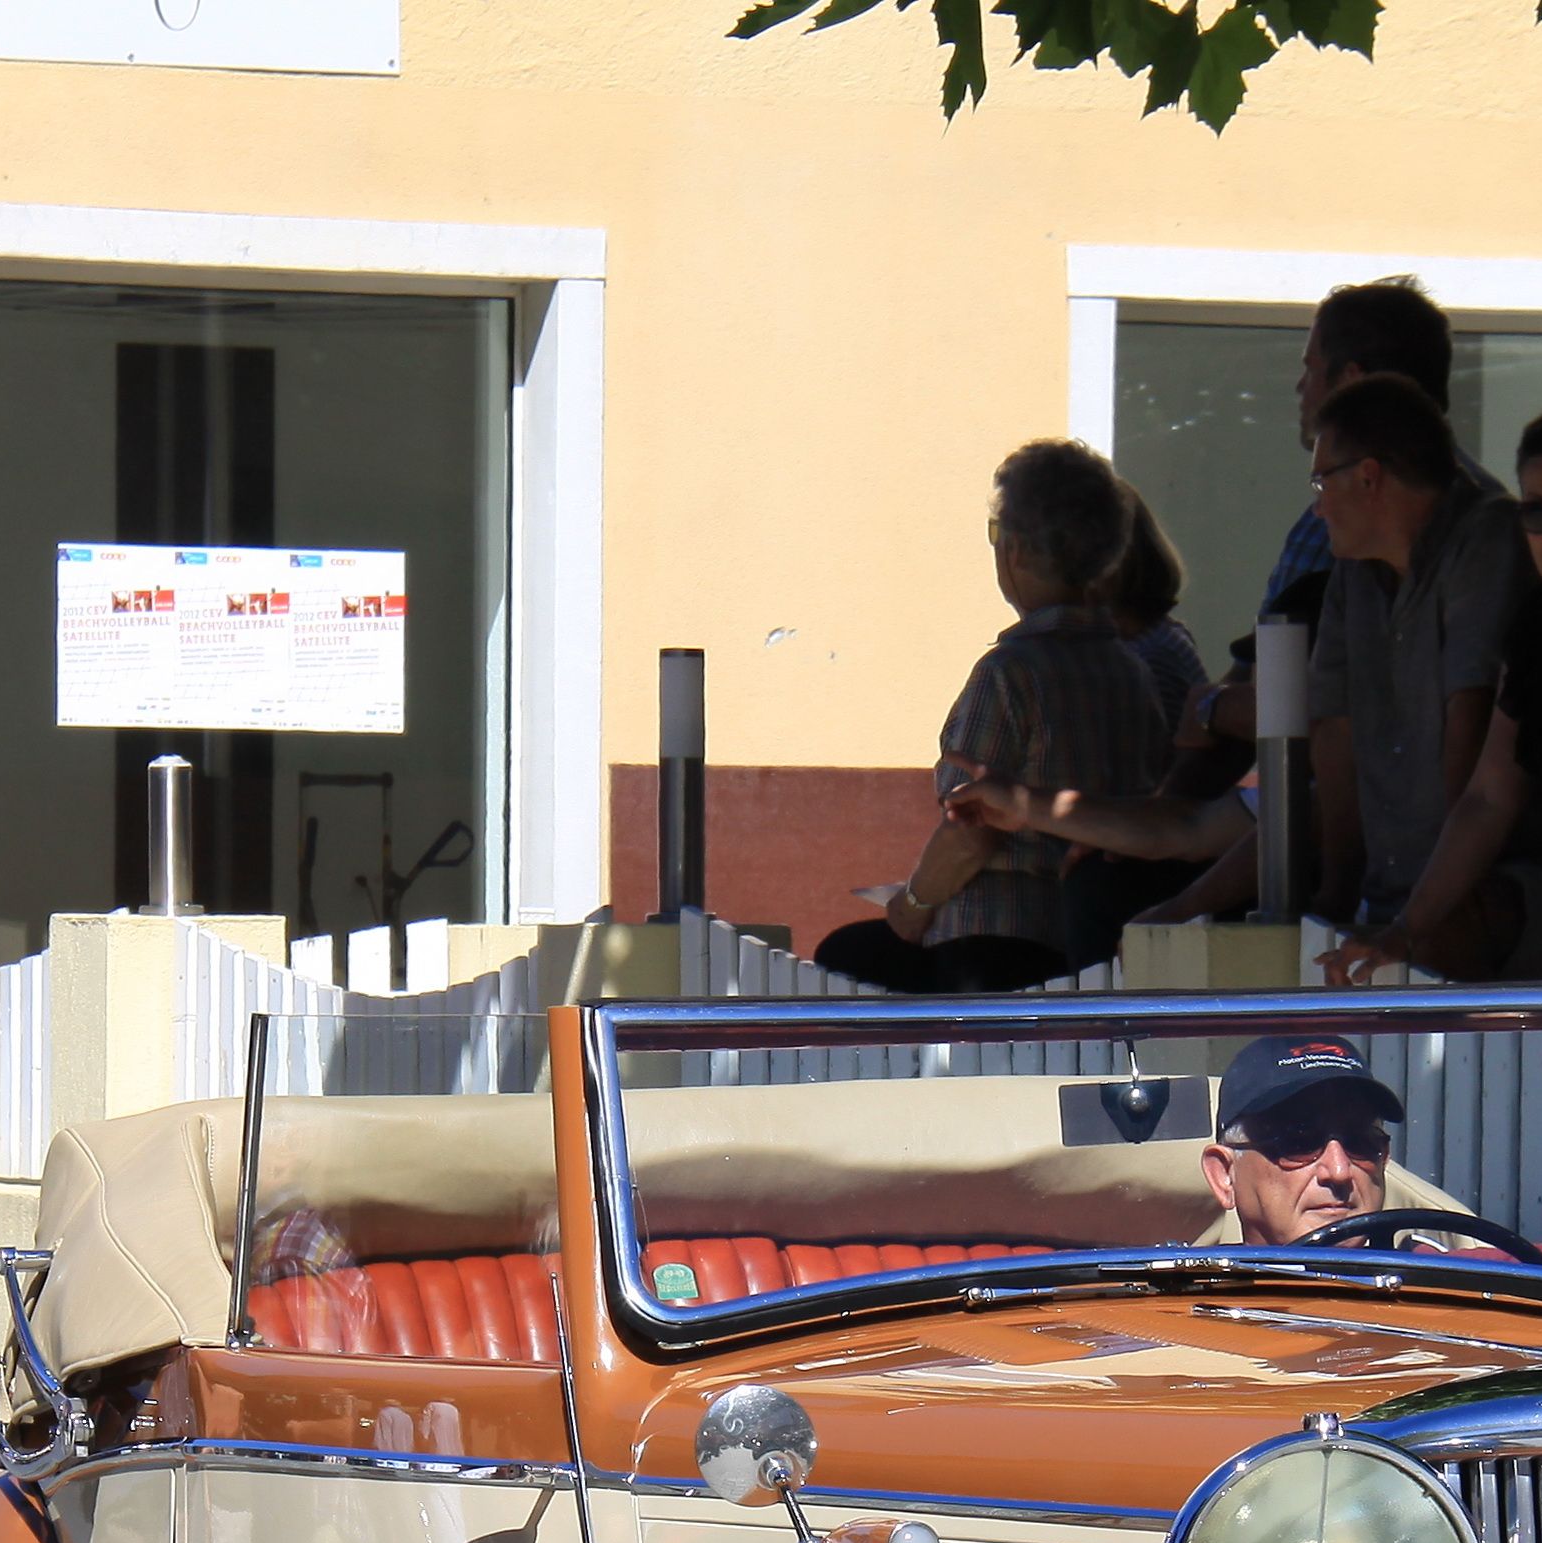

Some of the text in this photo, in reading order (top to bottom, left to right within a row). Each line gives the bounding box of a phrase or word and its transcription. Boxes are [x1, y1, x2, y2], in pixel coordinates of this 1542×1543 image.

[63, 606, 108, 617] 2012 CEV
[179, 608, 223, 620] 2012 CEV
[293, 611, 338, 622] 2012 CEV
[63, 616, 170, 629] BEACHVOLLEYBALL
[179, 619, 285, 632] BEACHVOLLEYBALL
[293, 621, 400, 634] BEACHVOLLEYBALL
[63, 631, 121, 642] SATELLITE
[179, 634, 236, 645] SATELLITE
[294, 636, 350, 647] SATELLITE
